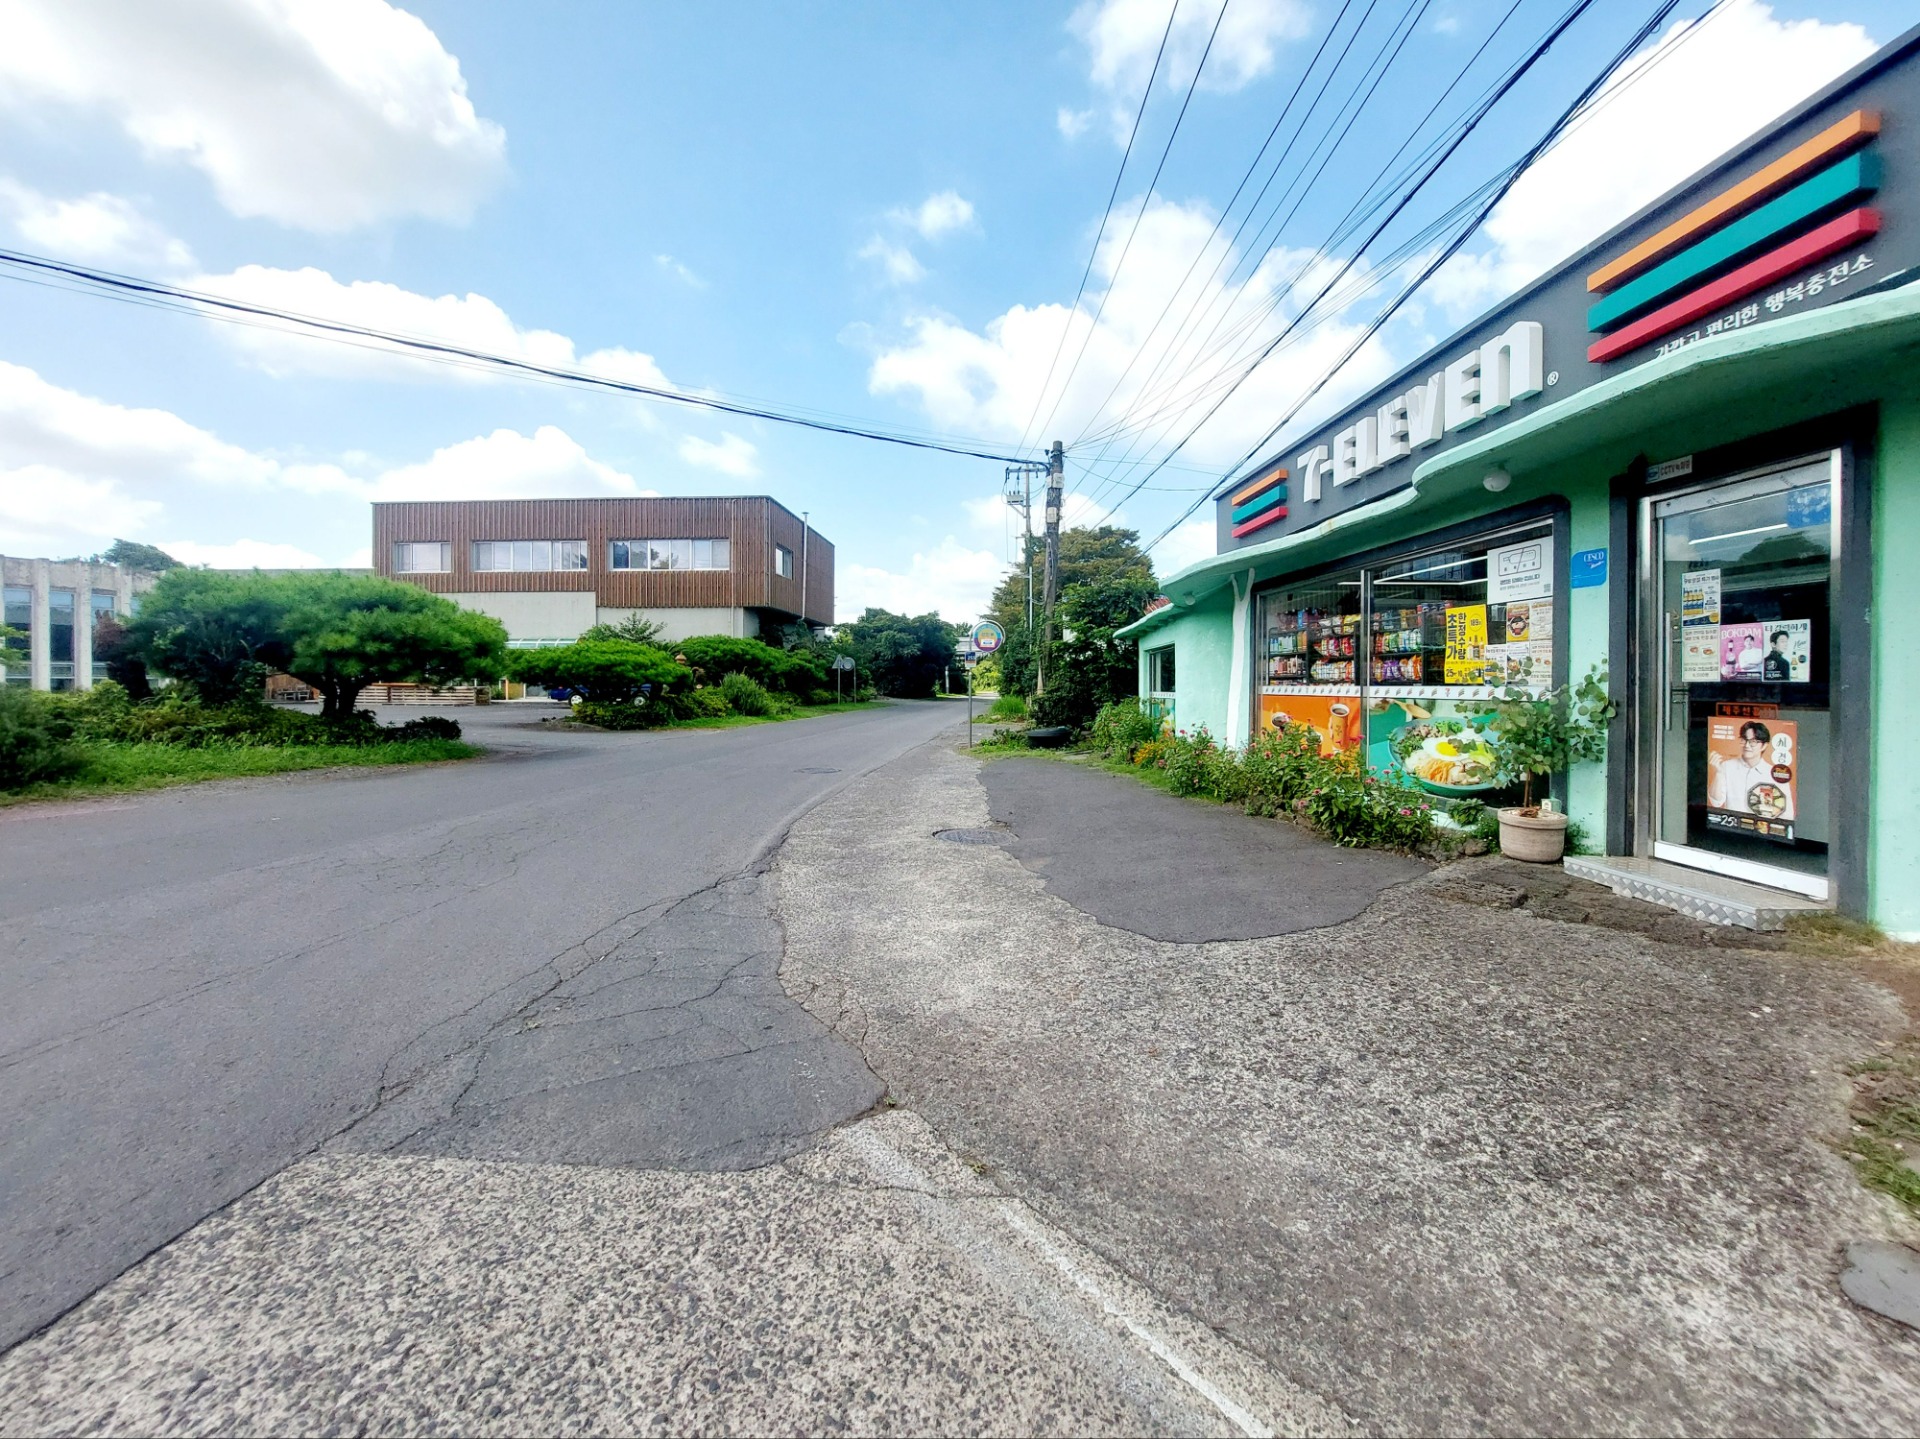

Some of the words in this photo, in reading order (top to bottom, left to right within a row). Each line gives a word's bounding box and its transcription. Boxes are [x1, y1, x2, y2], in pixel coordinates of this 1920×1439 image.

[1706, 304, 1760, 336] 편리한
[1764, 253, 1874, 313] 행복충전소
[1583, 551, 1605, 563] CESCO
[1446, 613, 1457, 660] 초특가
[1457, 612, 1467, 660] 한정수량
[1721, 627, 1761, 639] BOKDAM
